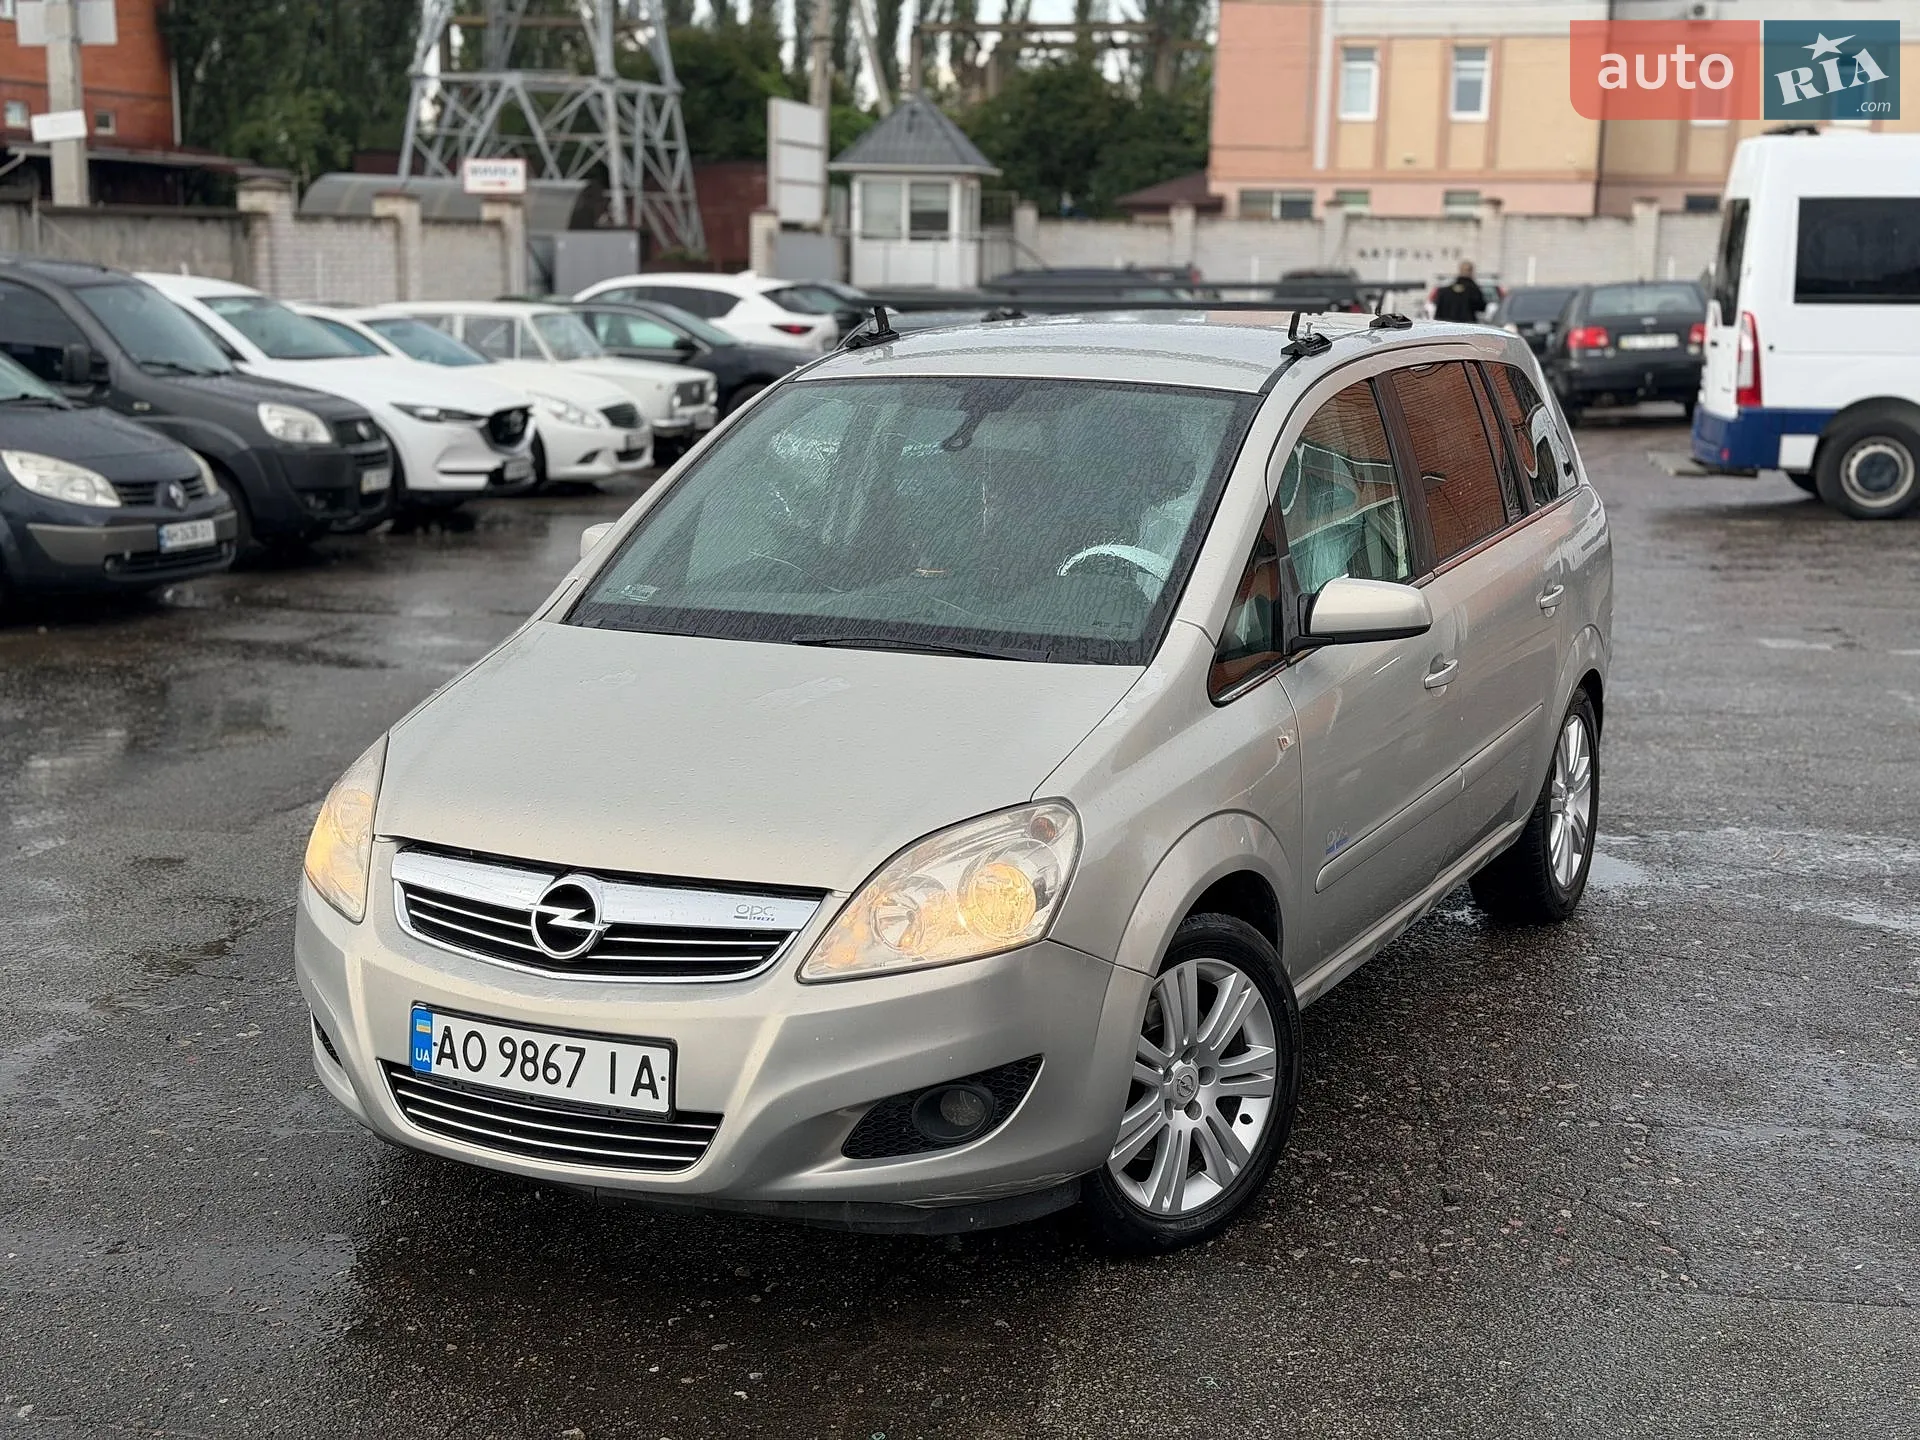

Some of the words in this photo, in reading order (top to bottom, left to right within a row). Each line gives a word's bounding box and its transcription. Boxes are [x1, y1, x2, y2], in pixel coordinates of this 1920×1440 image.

[415, 1048, 430, 1063] UA
[435, 1025, 487, 1073] AO
[498, 1035, 586, 1089] 9867
[609, 1050, 659, 1100] IA
